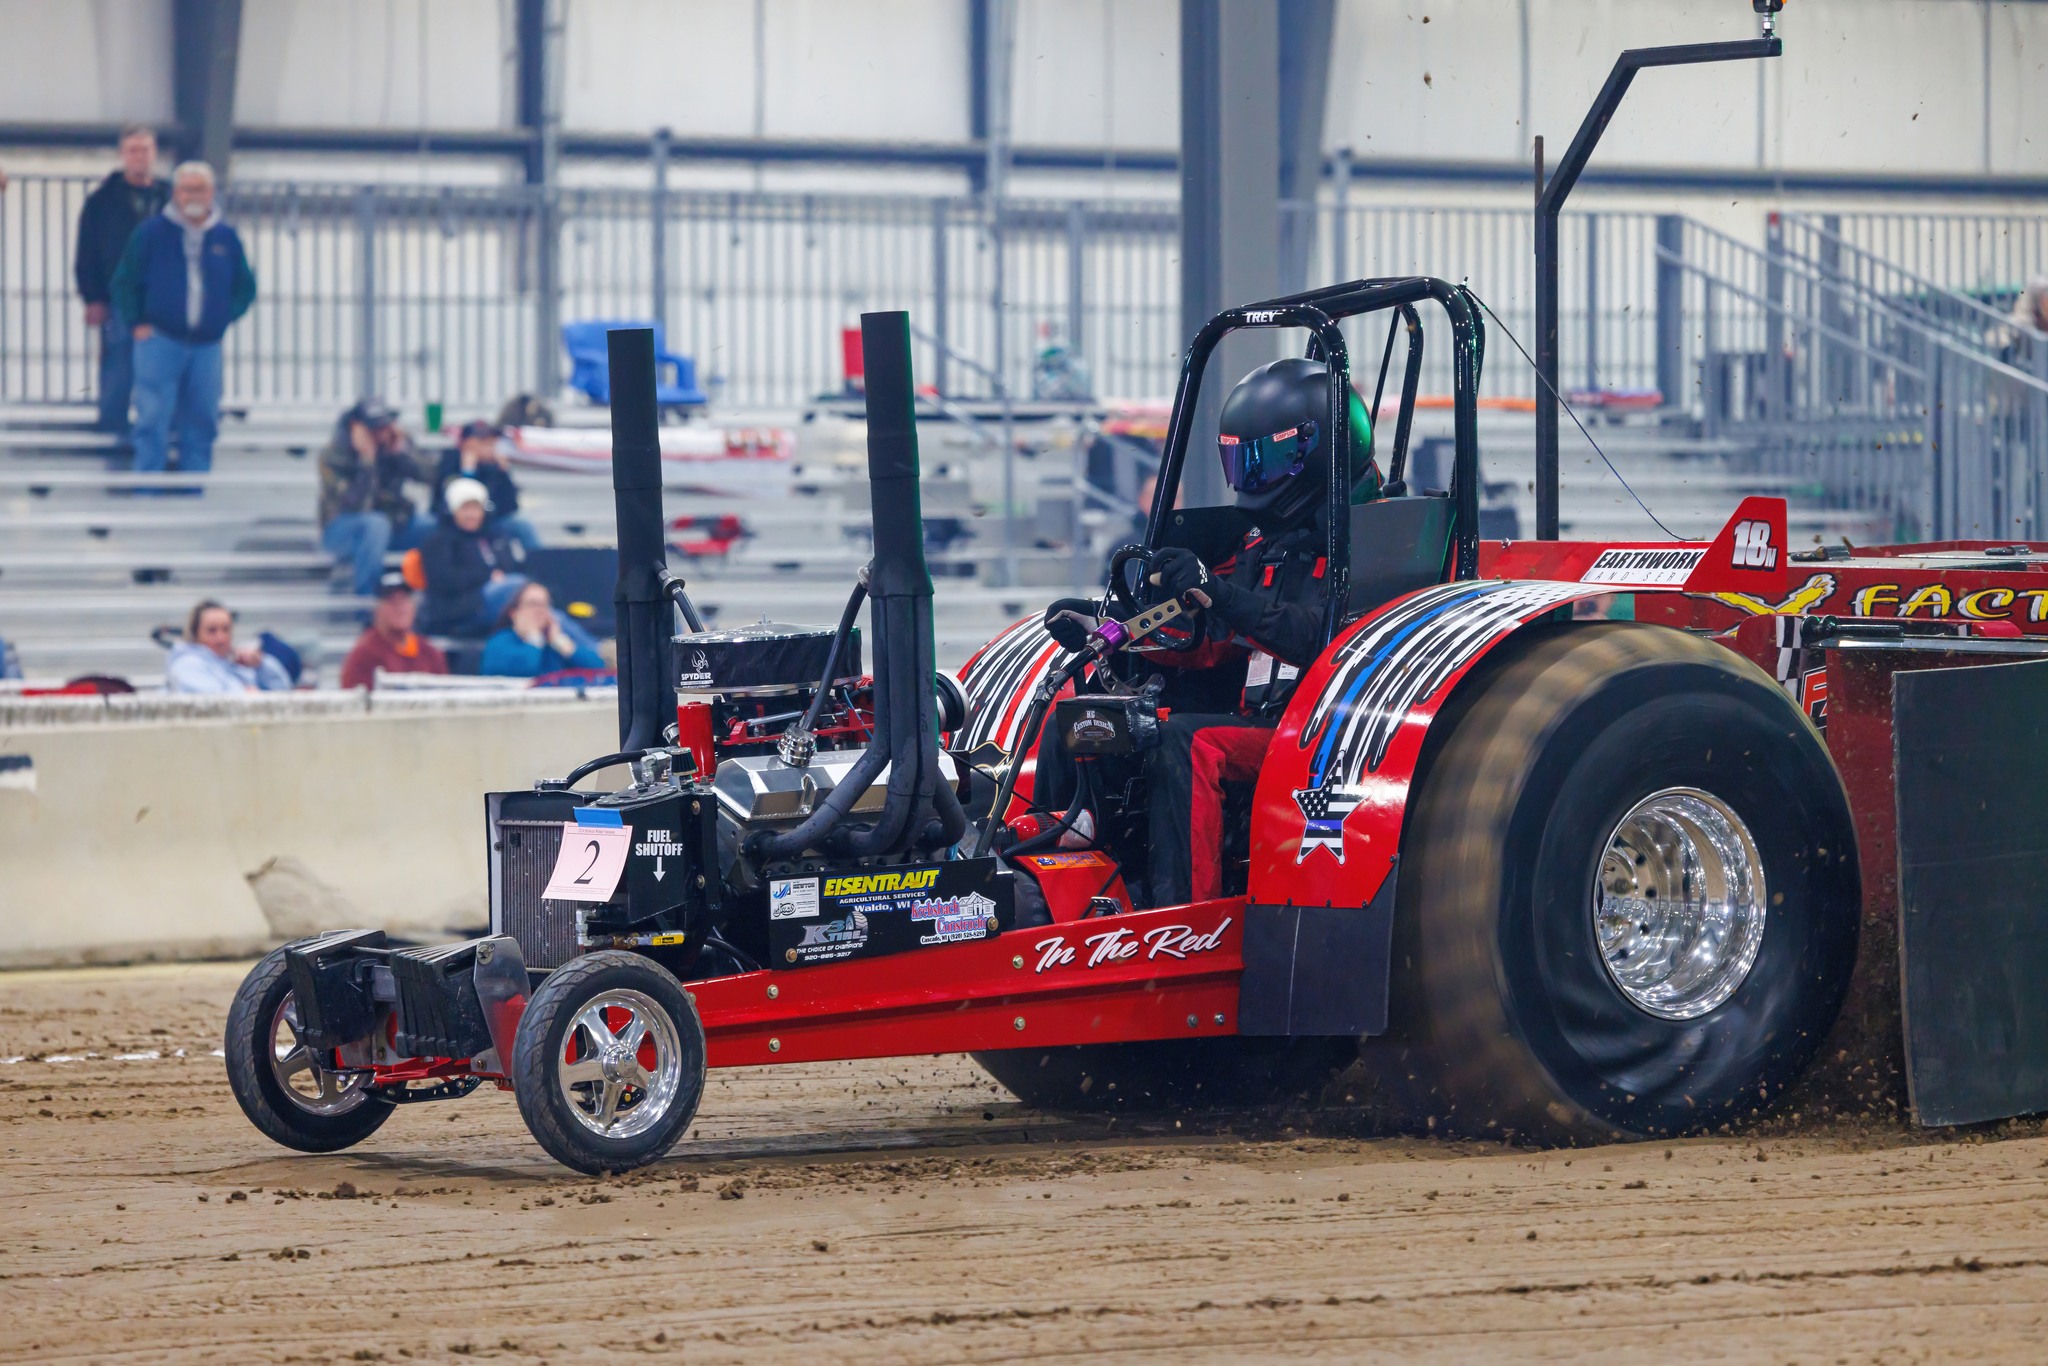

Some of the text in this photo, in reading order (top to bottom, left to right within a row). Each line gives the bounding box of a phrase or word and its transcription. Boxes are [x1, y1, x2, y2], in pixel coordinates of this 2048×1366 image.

[1244, 310, 1280, 323] TREY
[1594, 551, 1705, 569] EARTHWORK
[1584, 571, 1631, 581] LAND
[1852, 583, 2048, 622] FACT
[681, 672, 712, 680] SPYDER
[647, 829, 672, 843] FUEL
[635, 843, 684, 856] SHUTOFF
[573, 840, 601, 885] 2
[823, 869, 940, 897] EISENTRAUT
[839, 891, 926, 905] AGRICULTURAL SERVICES
[854, 900, 911, 912] Waldo, WI
[911, 897, 960, 920] Krebsbach
[828, 930, 862, 942] TIRE
[1035, 917, 1233, 974] In The Red
